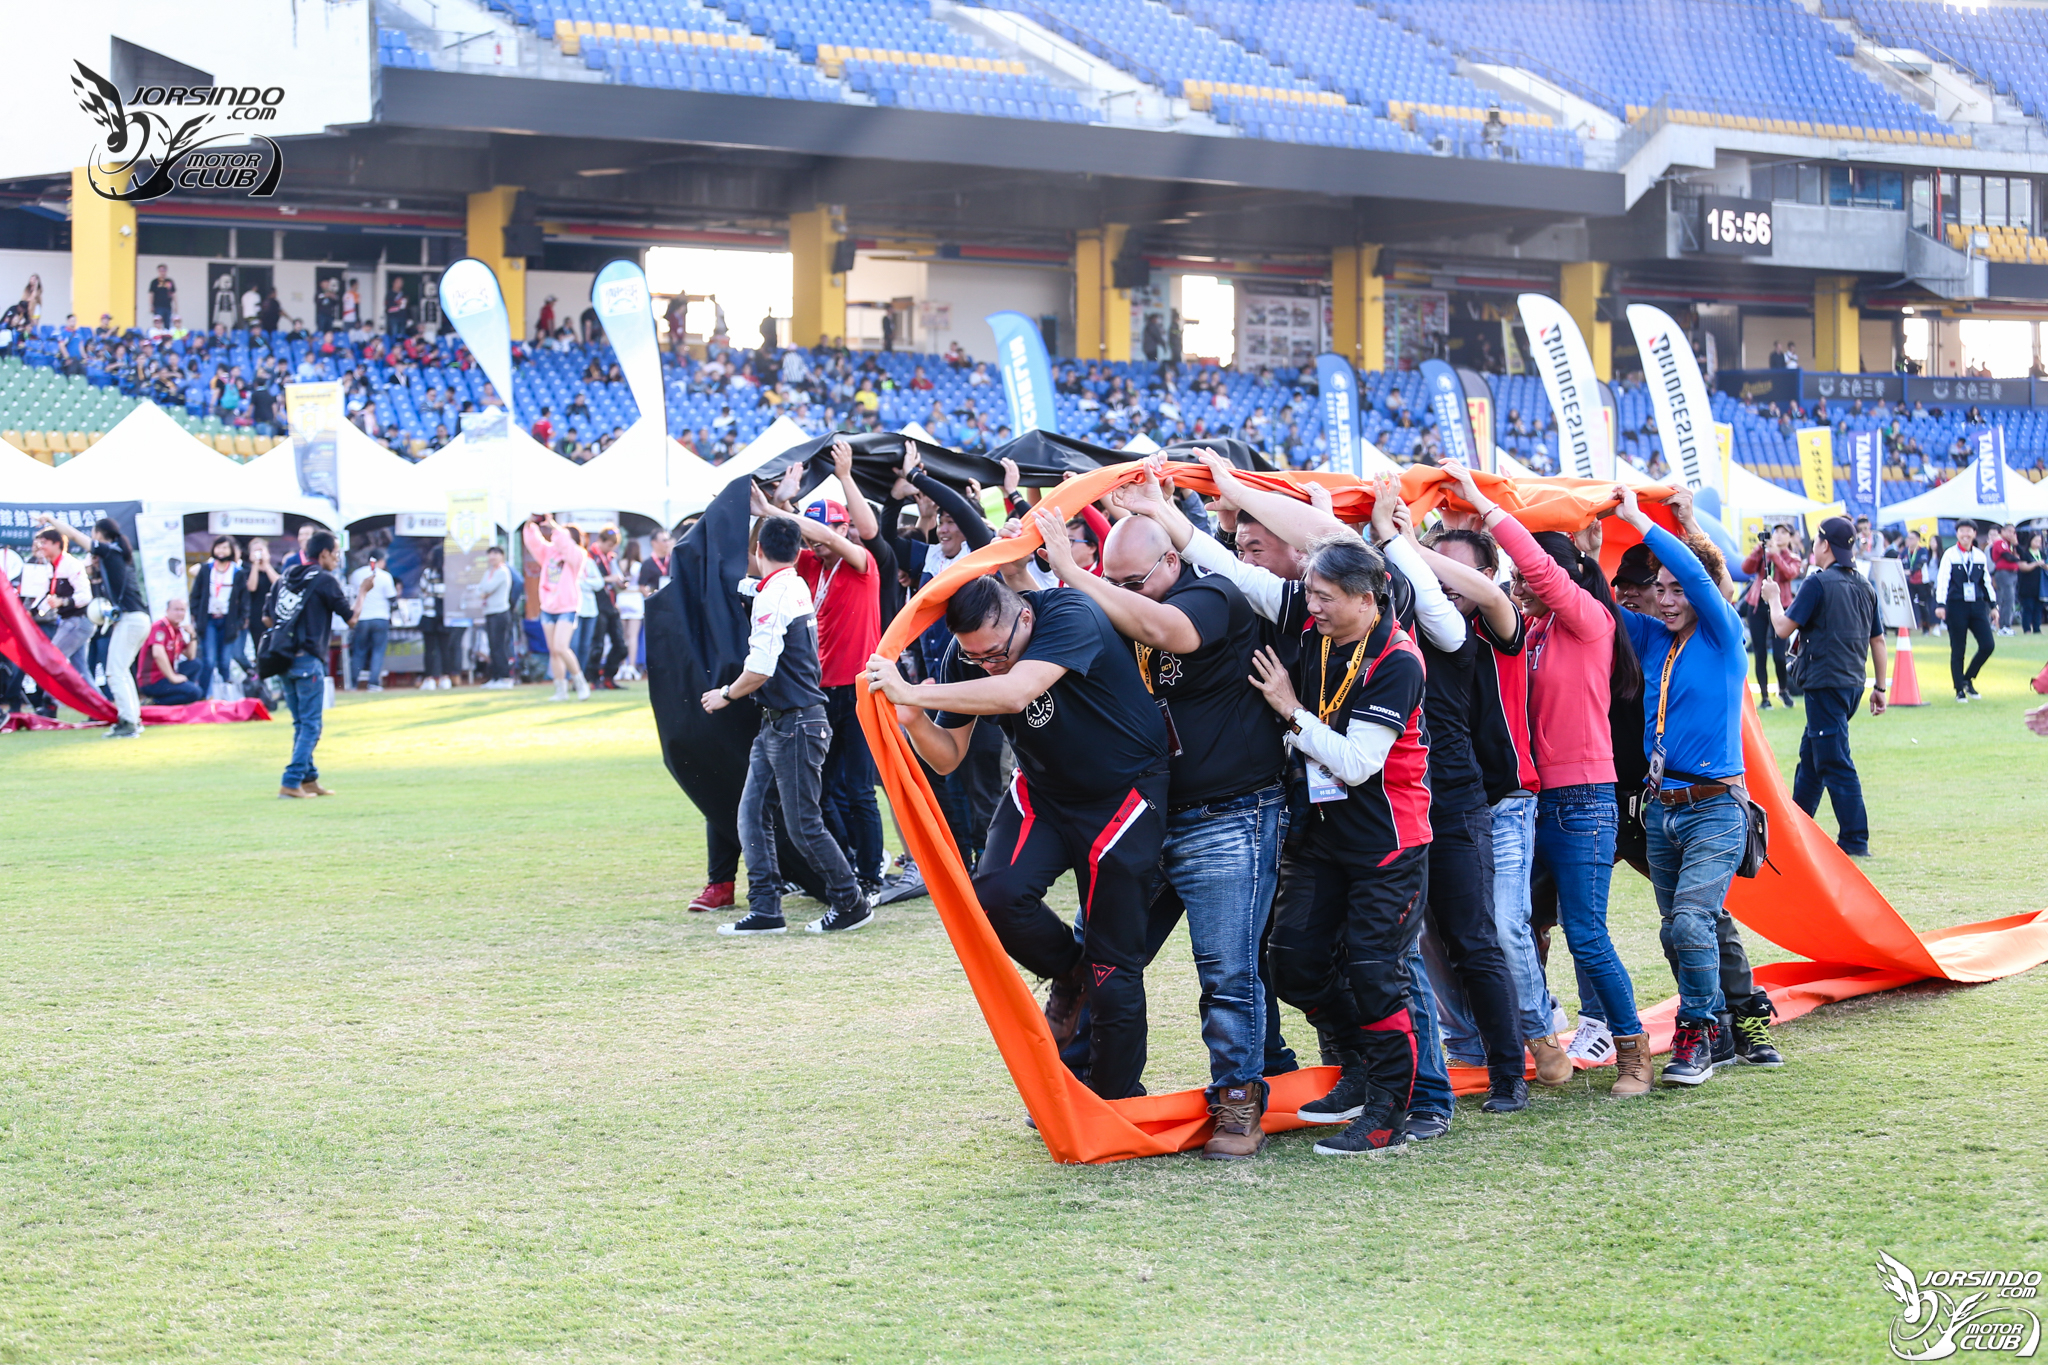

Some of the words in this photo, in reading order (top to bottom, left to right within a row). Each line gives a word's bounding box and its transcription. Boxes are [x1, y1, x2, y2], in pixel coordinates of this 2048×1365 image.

[1707, 208, 1771, 245] 15:56
[1856, 432, 1872, 493] TANAX
[1978, 430, 1997, 493] TANAX
[1663, 660, 1671, 682] HONDA
[1337, 677, 1352, 703] HONDA
[1044, 699, 1052, 712] THE
[1369, 704, 1401, 719] HONDA
